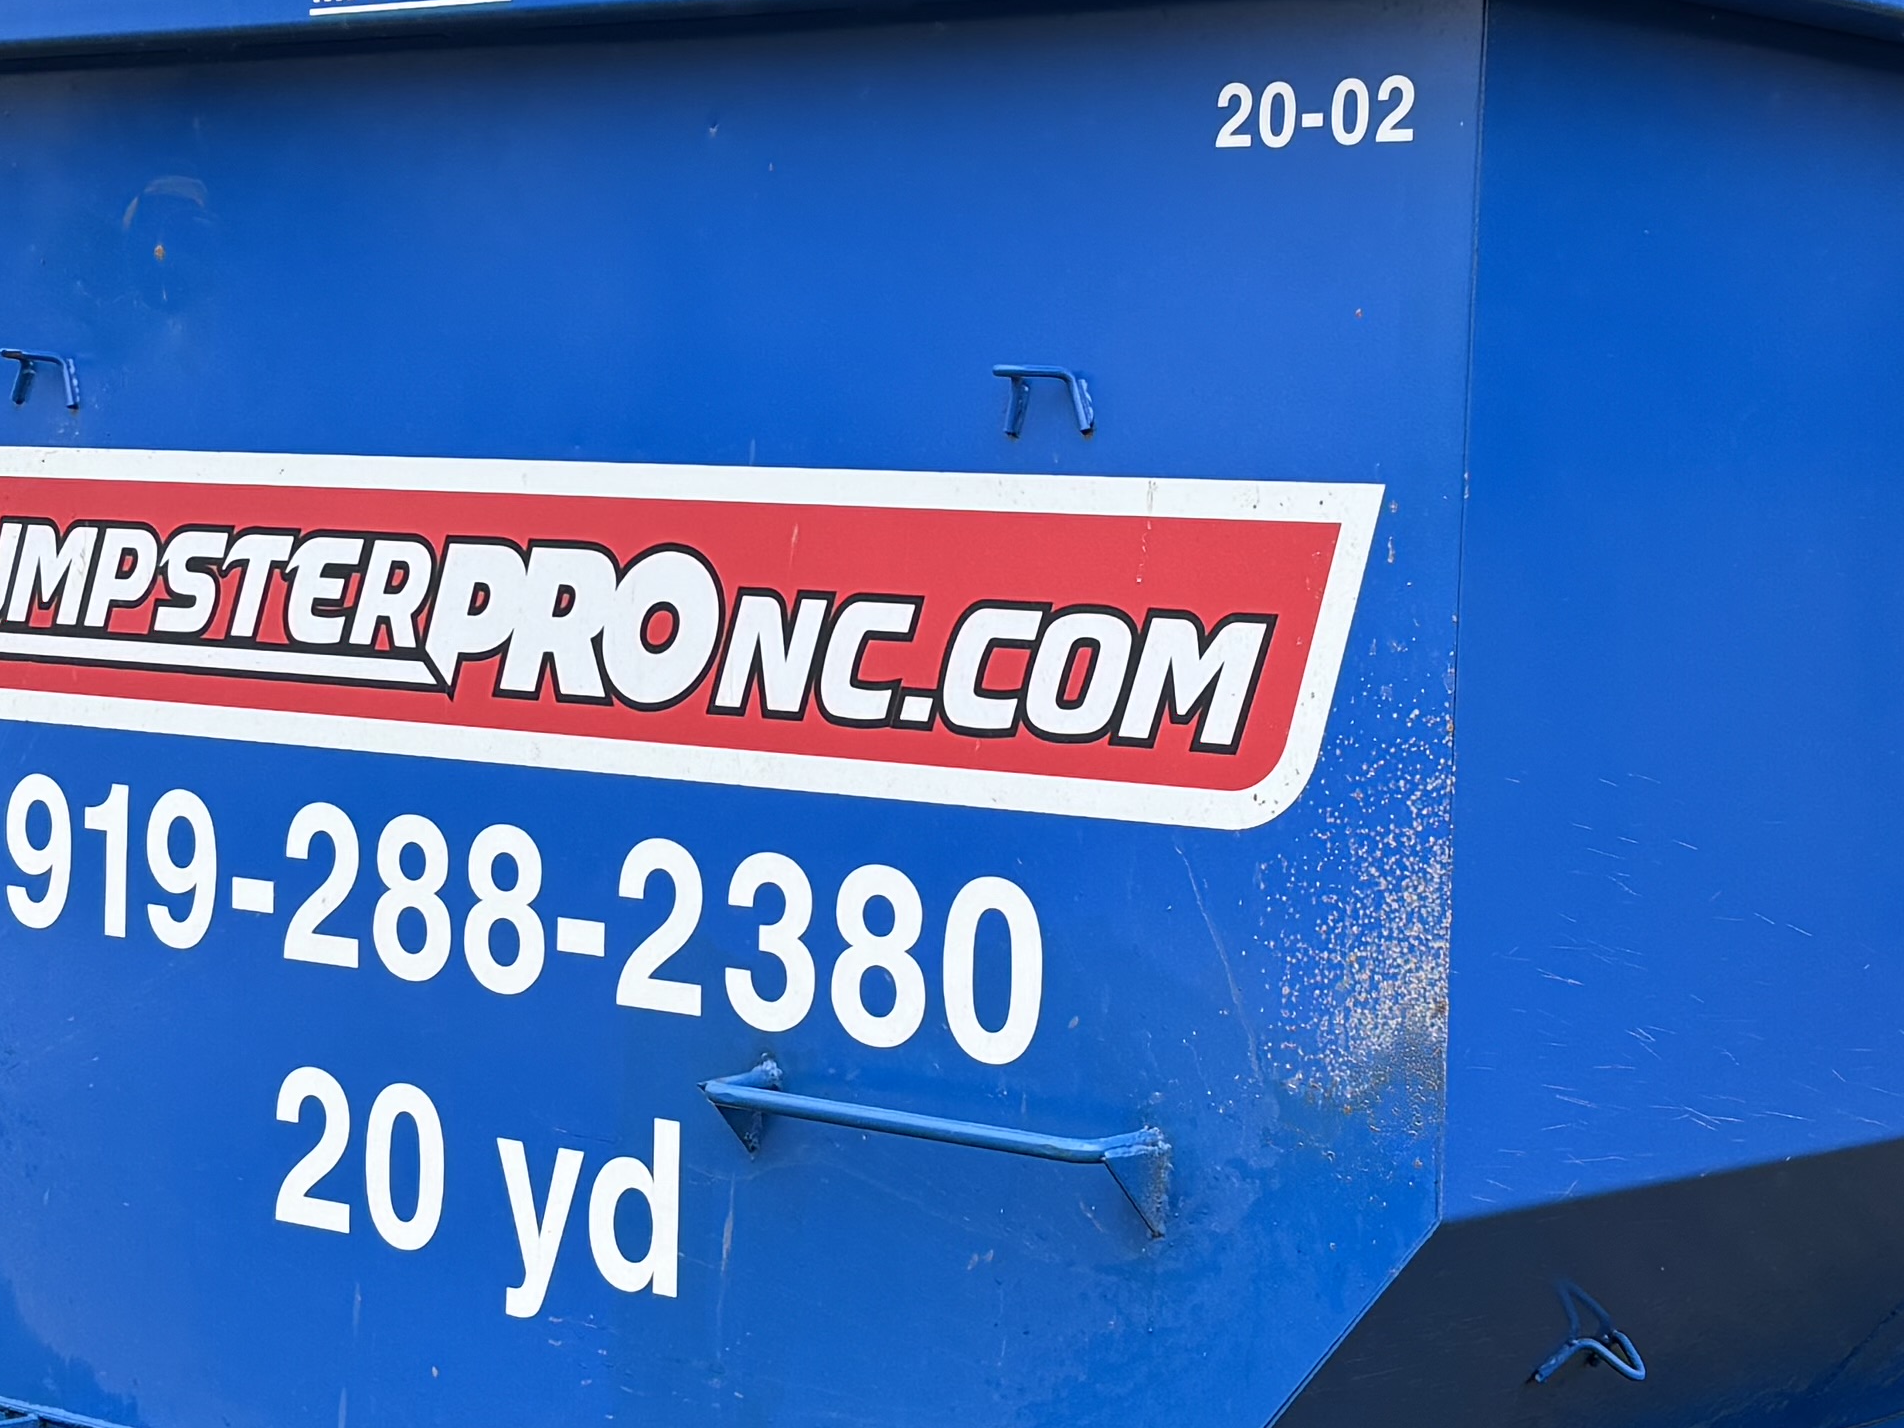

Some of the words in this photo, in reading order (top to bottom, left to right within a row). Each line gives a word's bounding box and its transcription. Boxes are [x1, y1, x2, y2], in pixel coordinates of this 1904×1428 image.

[1214, 74, 1416, 149] 20-02
[5, 772, 1044, 1066] 919-288-2380
[274, 1065, 446, 1252] 20
[495, 1117, 681, 1319] yd
